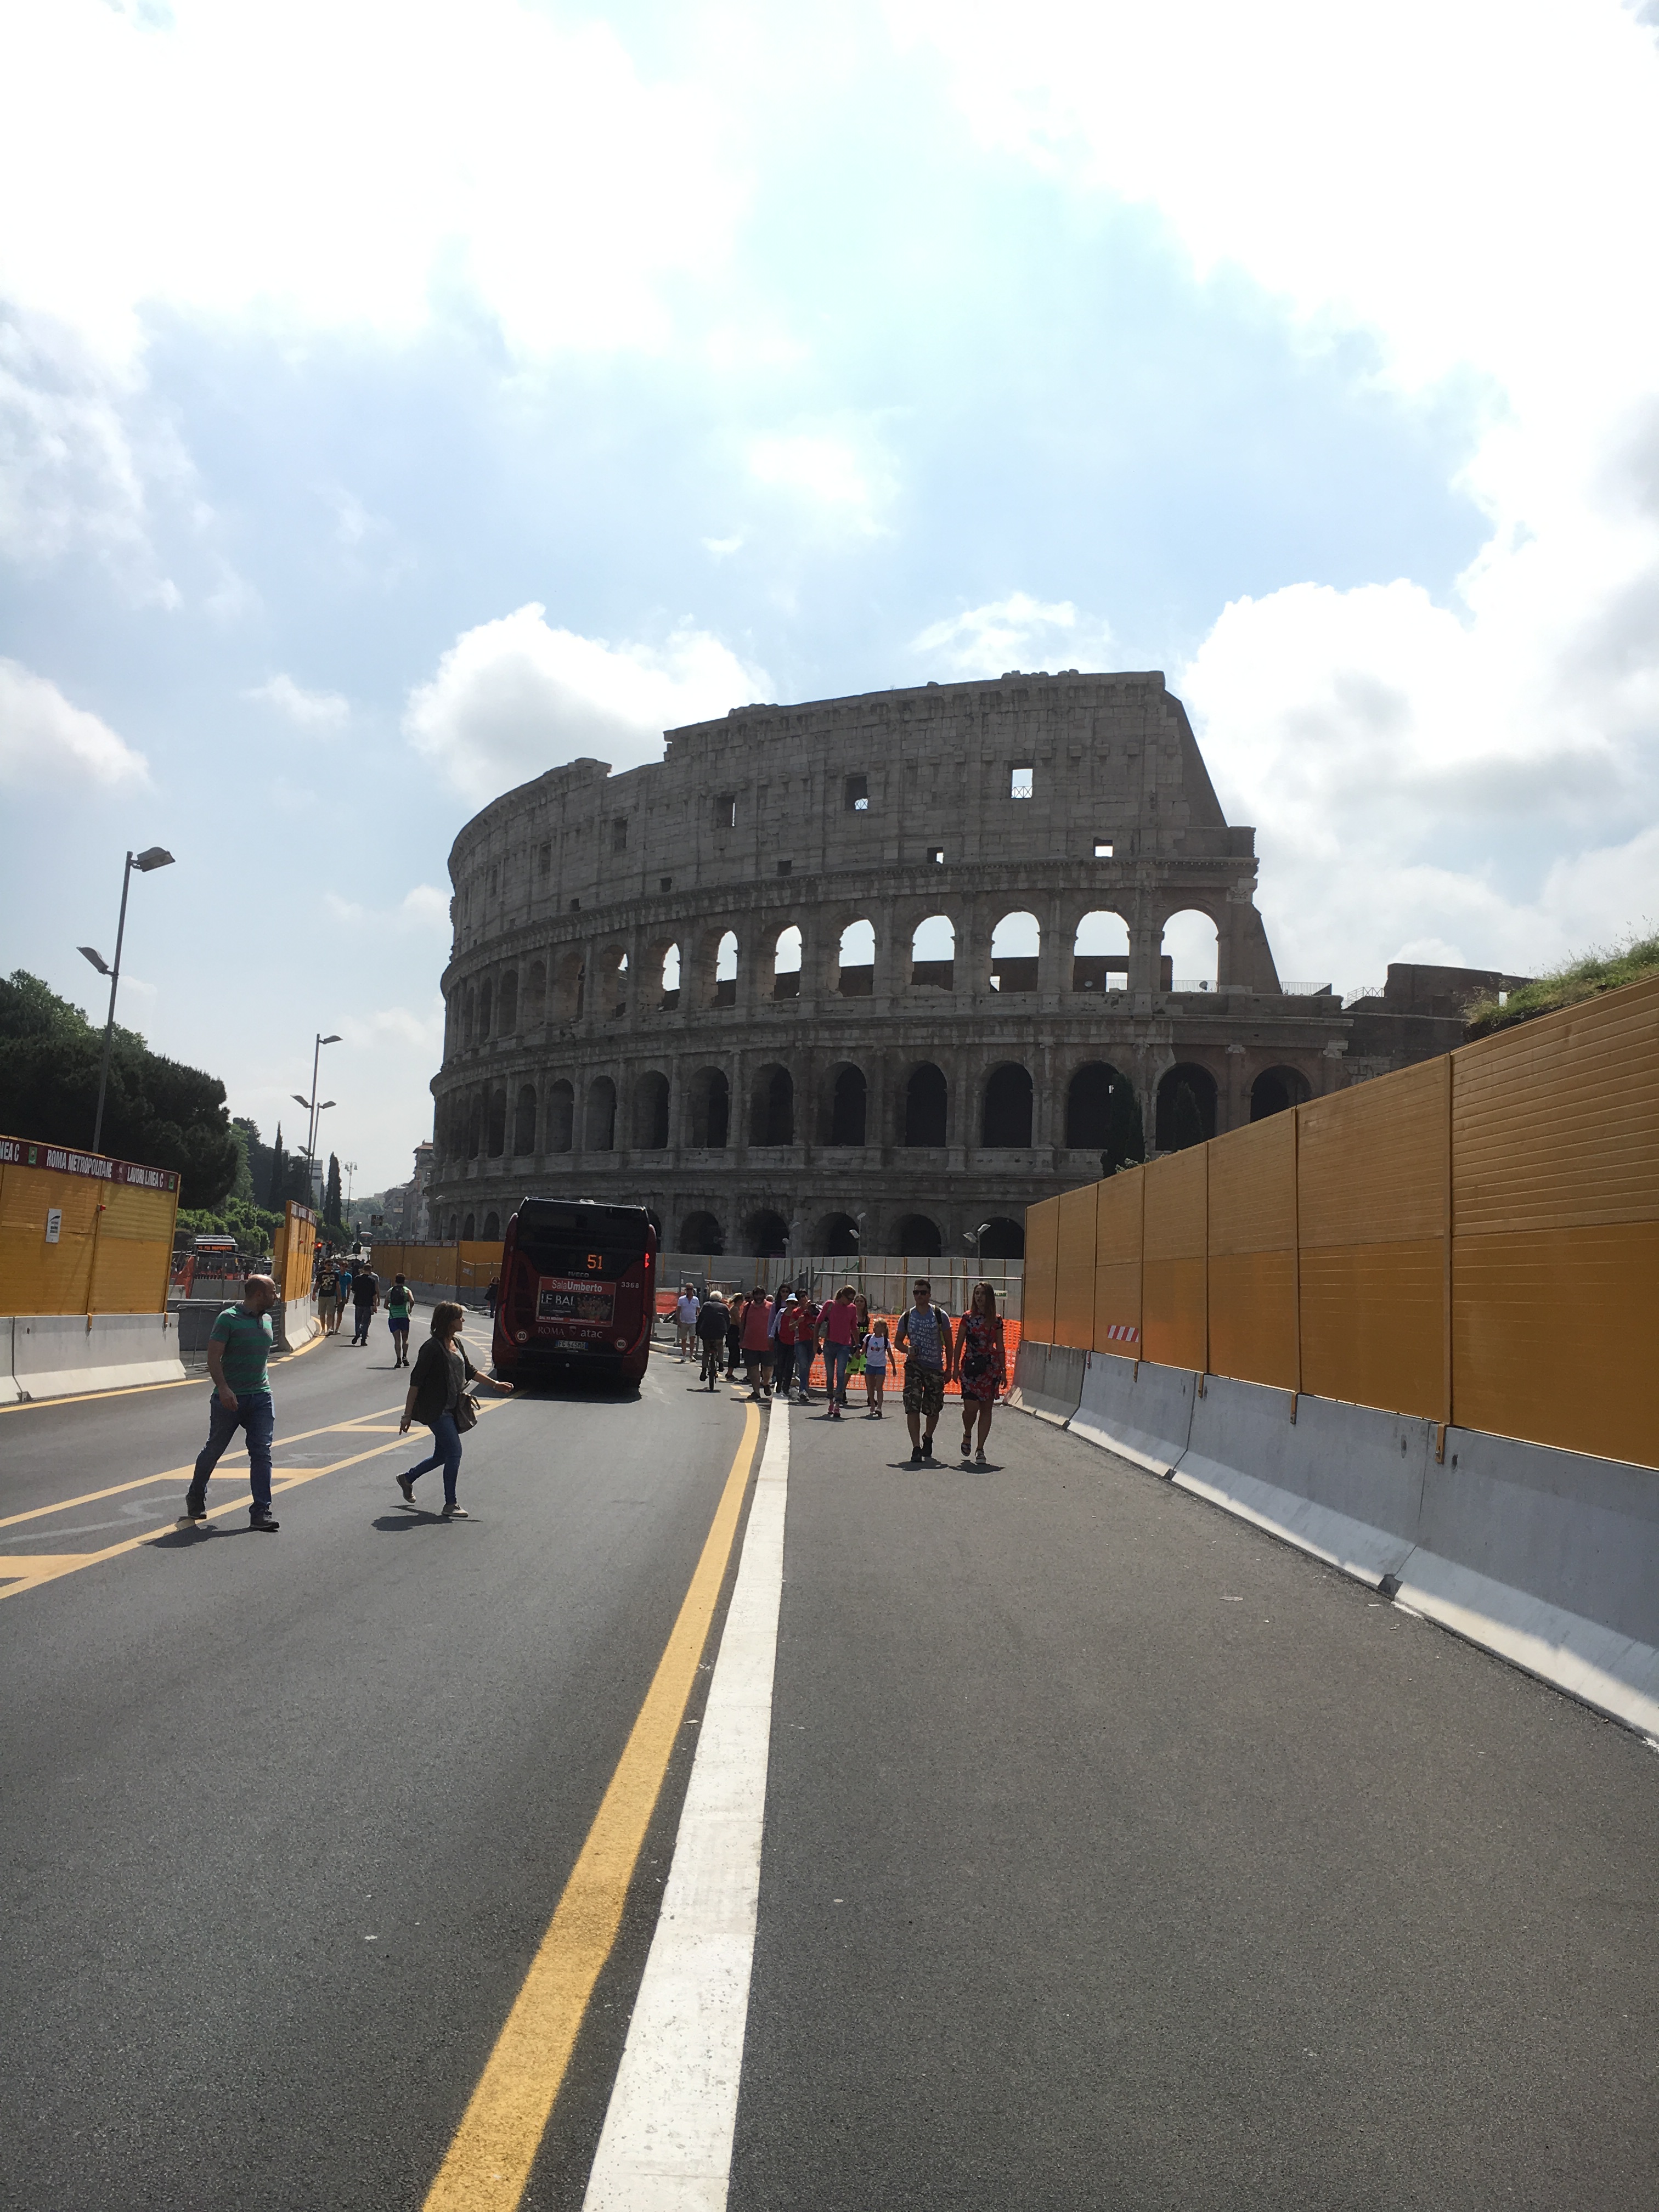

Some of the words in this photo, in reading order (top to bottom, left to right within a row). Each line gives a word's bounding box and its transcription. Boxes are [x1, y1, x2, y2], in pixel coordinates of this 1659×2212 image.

[15, 1143, 20, 1162] C
[46, 1149, 66, 1169] ROMA
[68, 1154, 113, 1178] METROPOLITANE
[127, 1166, 145, 1184] LAVORI
[145, 1170, 159, 1187] LINEA
[159, 1173, 163, 1188] C
[587, 1254, 602, 1269] 51
[541, 1293, 553, 1305] LE
[538, 1327, 565, 1337] ROMA
[580, 1329, 603, 1339] atac
